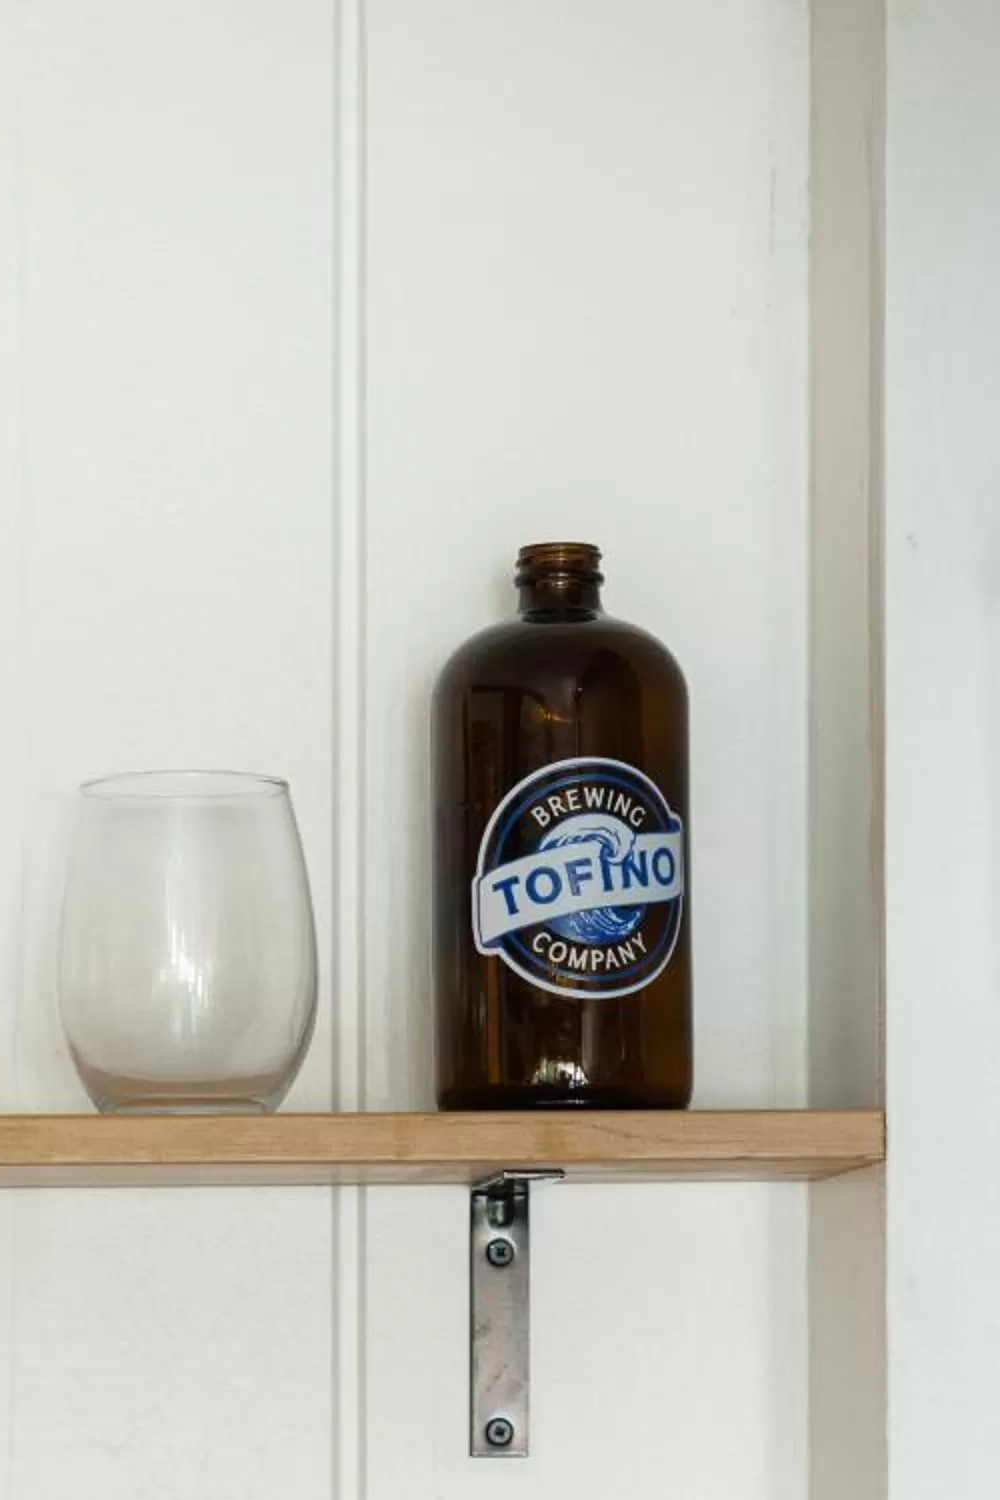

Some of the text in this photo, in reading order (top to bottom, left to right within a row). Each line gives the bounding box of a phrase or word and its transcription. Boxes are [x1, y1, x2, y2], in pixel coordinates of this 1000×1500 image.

[530, 786, 647, 828] BREWING
[491, 845, 676, 916] TOFINO
[532, 931, 648, 972] COMPANY
